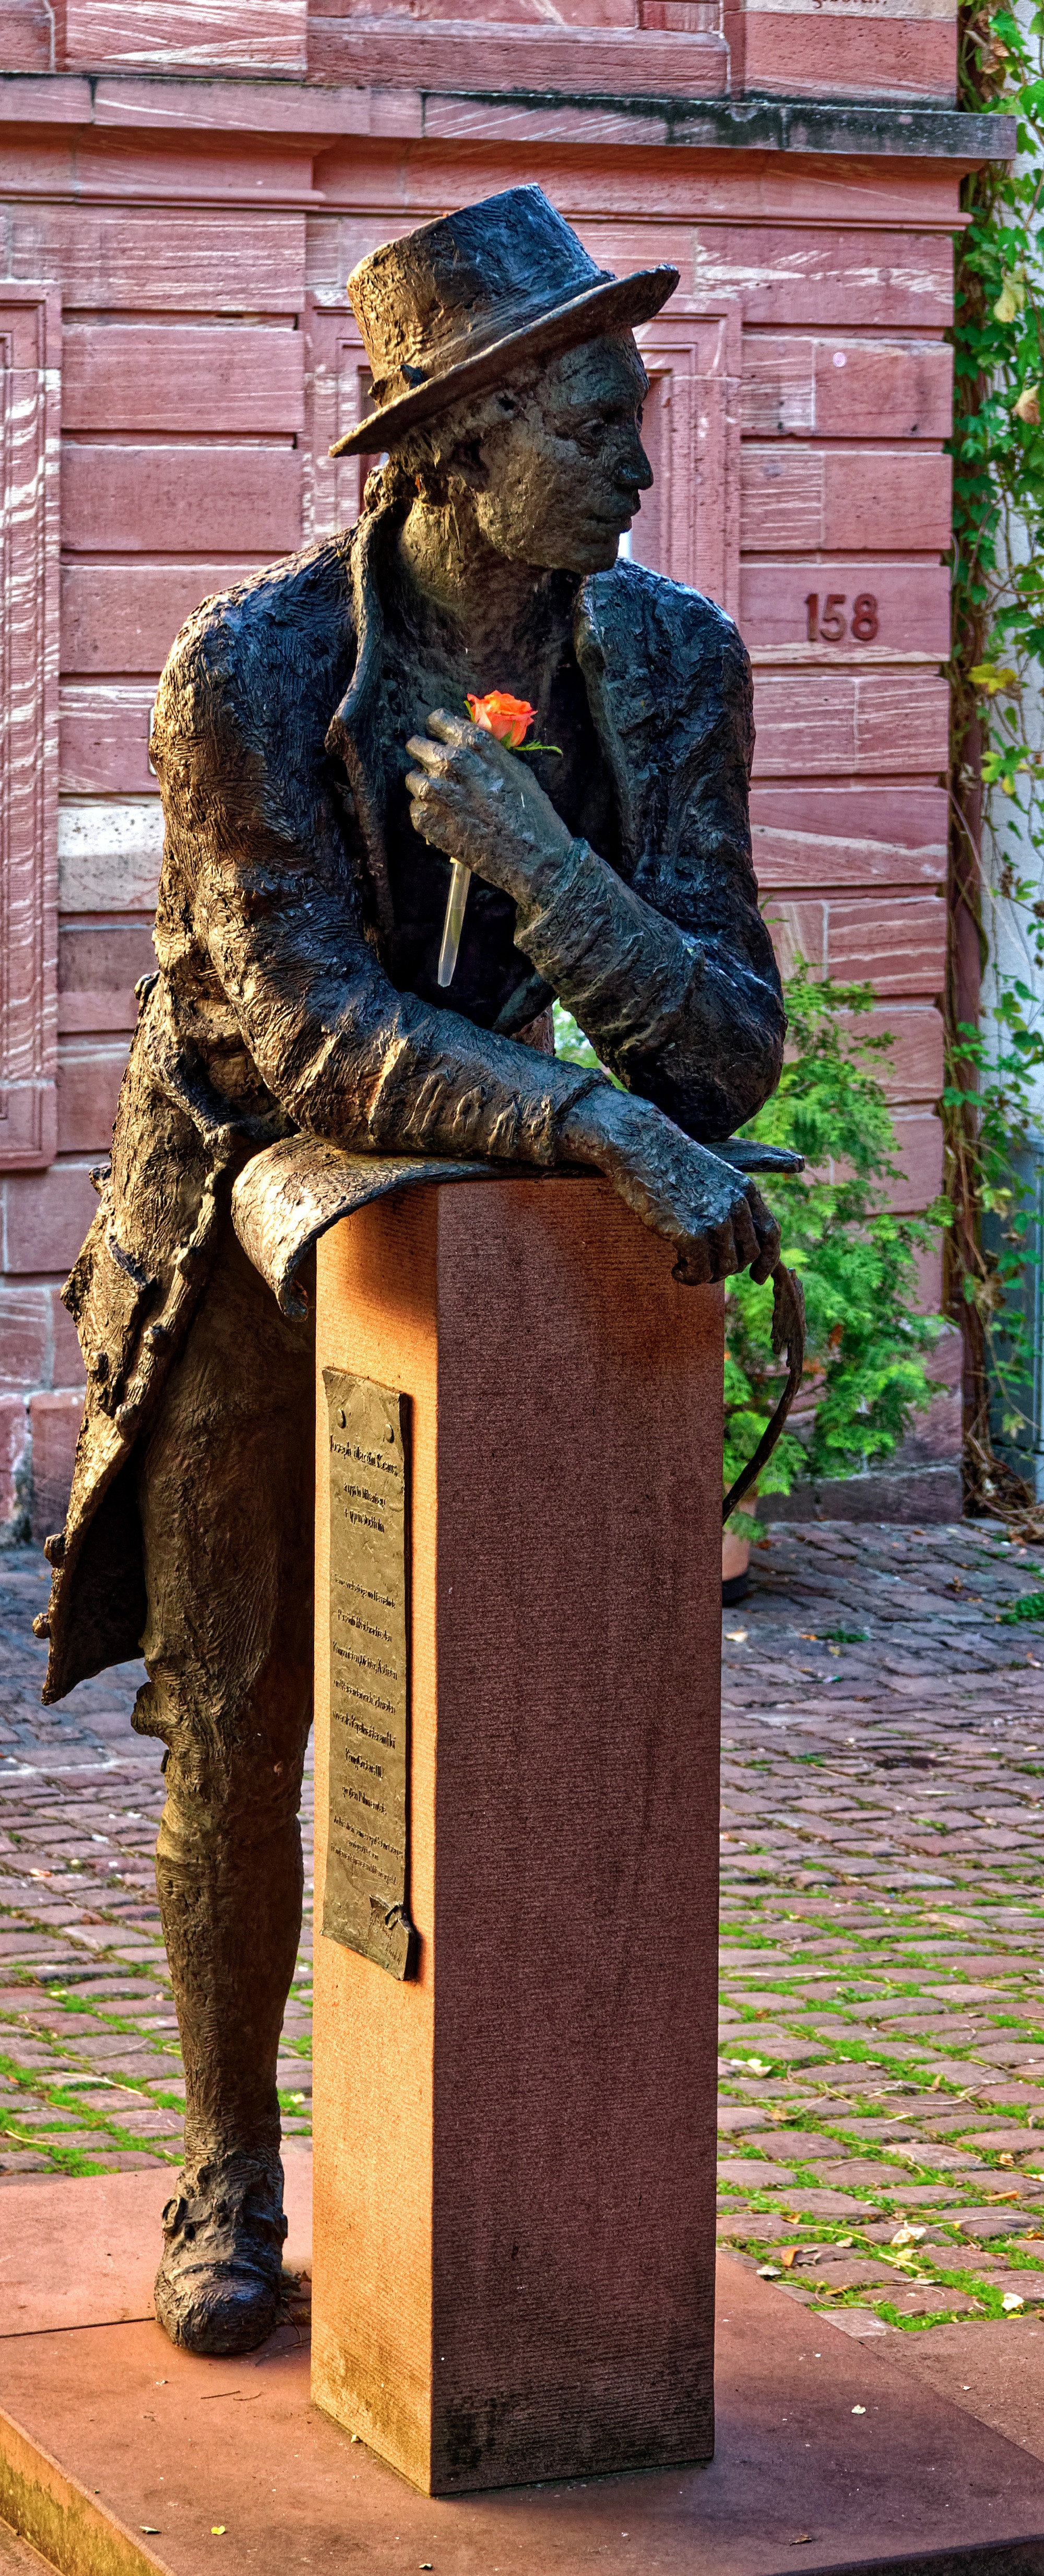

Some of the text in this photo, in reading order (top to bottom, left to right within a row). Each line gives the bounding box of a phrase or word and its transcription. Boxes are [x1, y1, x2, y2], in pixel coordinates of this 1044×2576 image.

[805, 593, 880, 642] 158
[330, 1434, 351, 1458] Joseph
[354, 1445, 376, 1466] Martin
[362, 1515, 384, 1533] Stockholm
